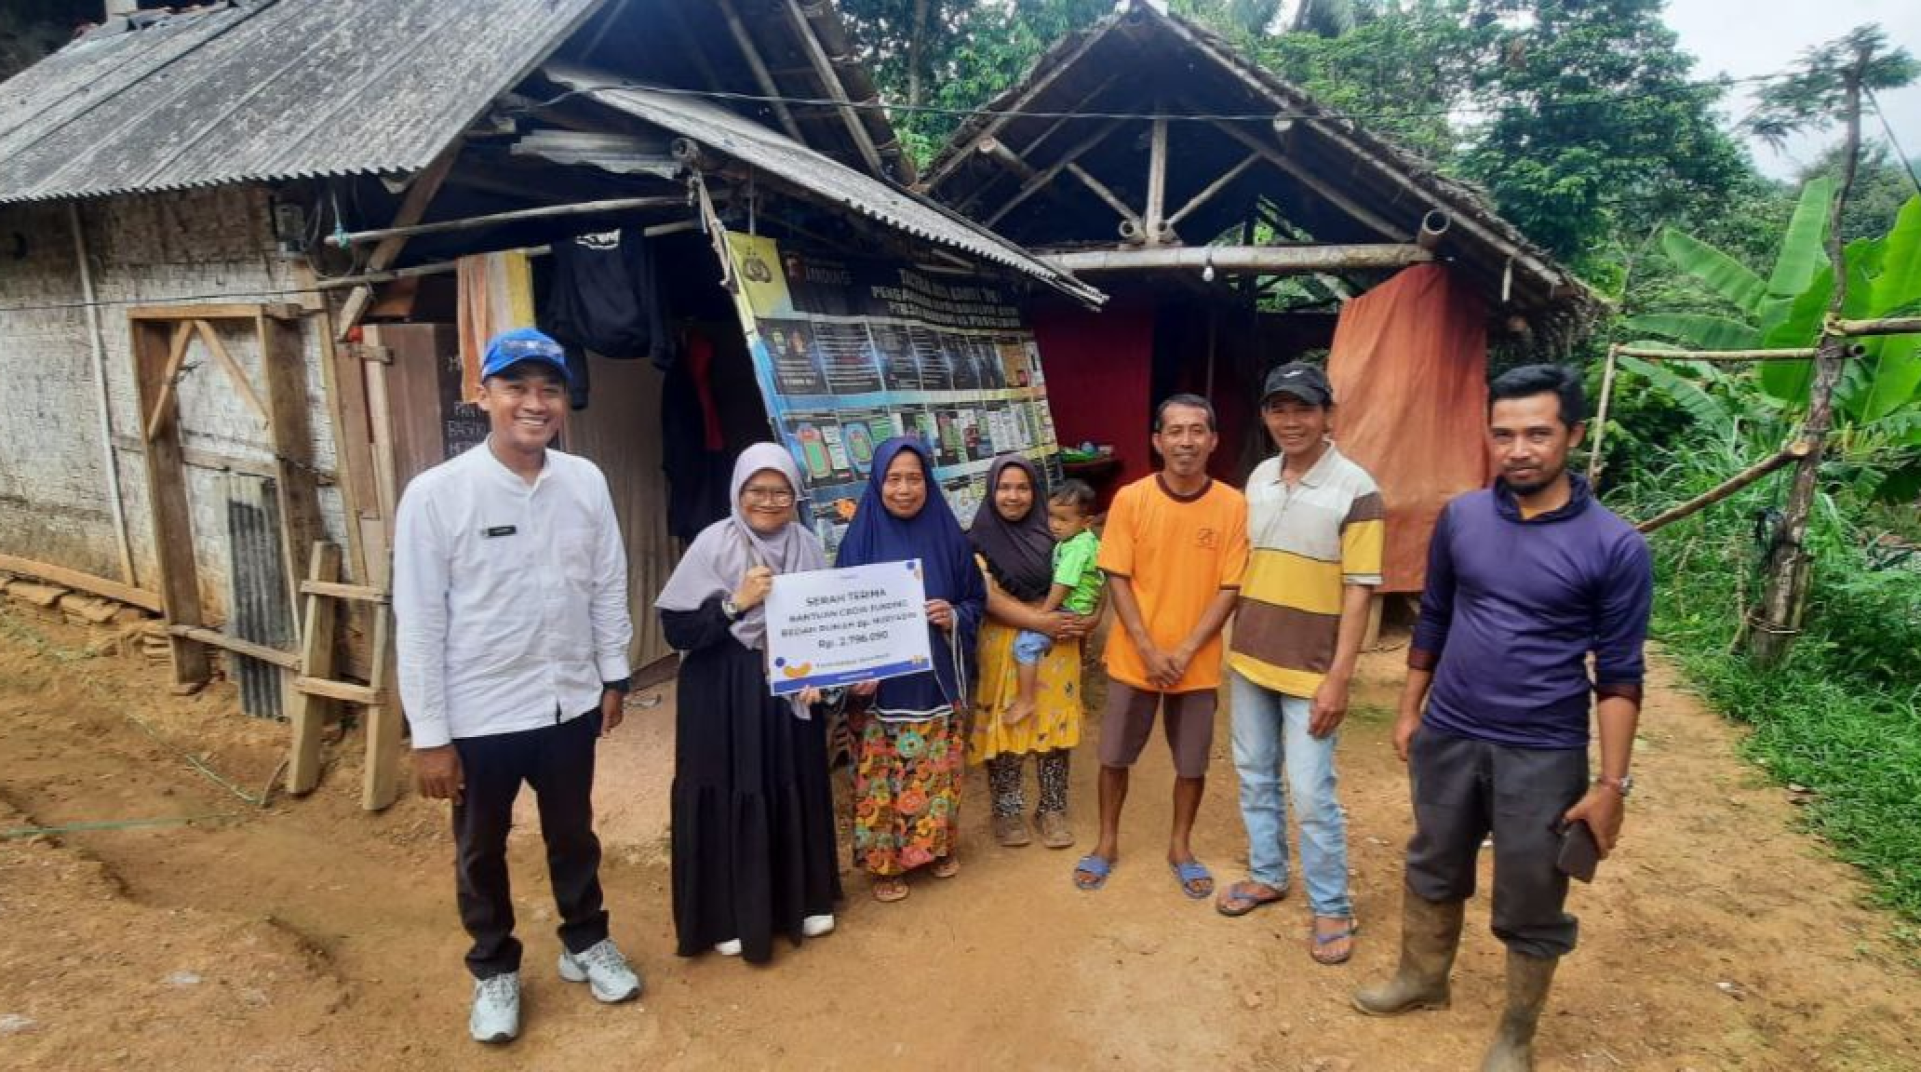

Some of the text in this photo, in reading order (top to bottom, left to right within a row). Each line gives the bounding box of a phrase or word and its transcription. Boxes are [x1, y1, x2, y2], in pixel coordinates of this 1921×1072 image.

[806, 588, 886, 606] SERAH TERIMA
[788, 611, 837, 622] BANTUAN
[781, 626, 818, 637] BEDAH
[819, 622, 854, 632] RUMAH
